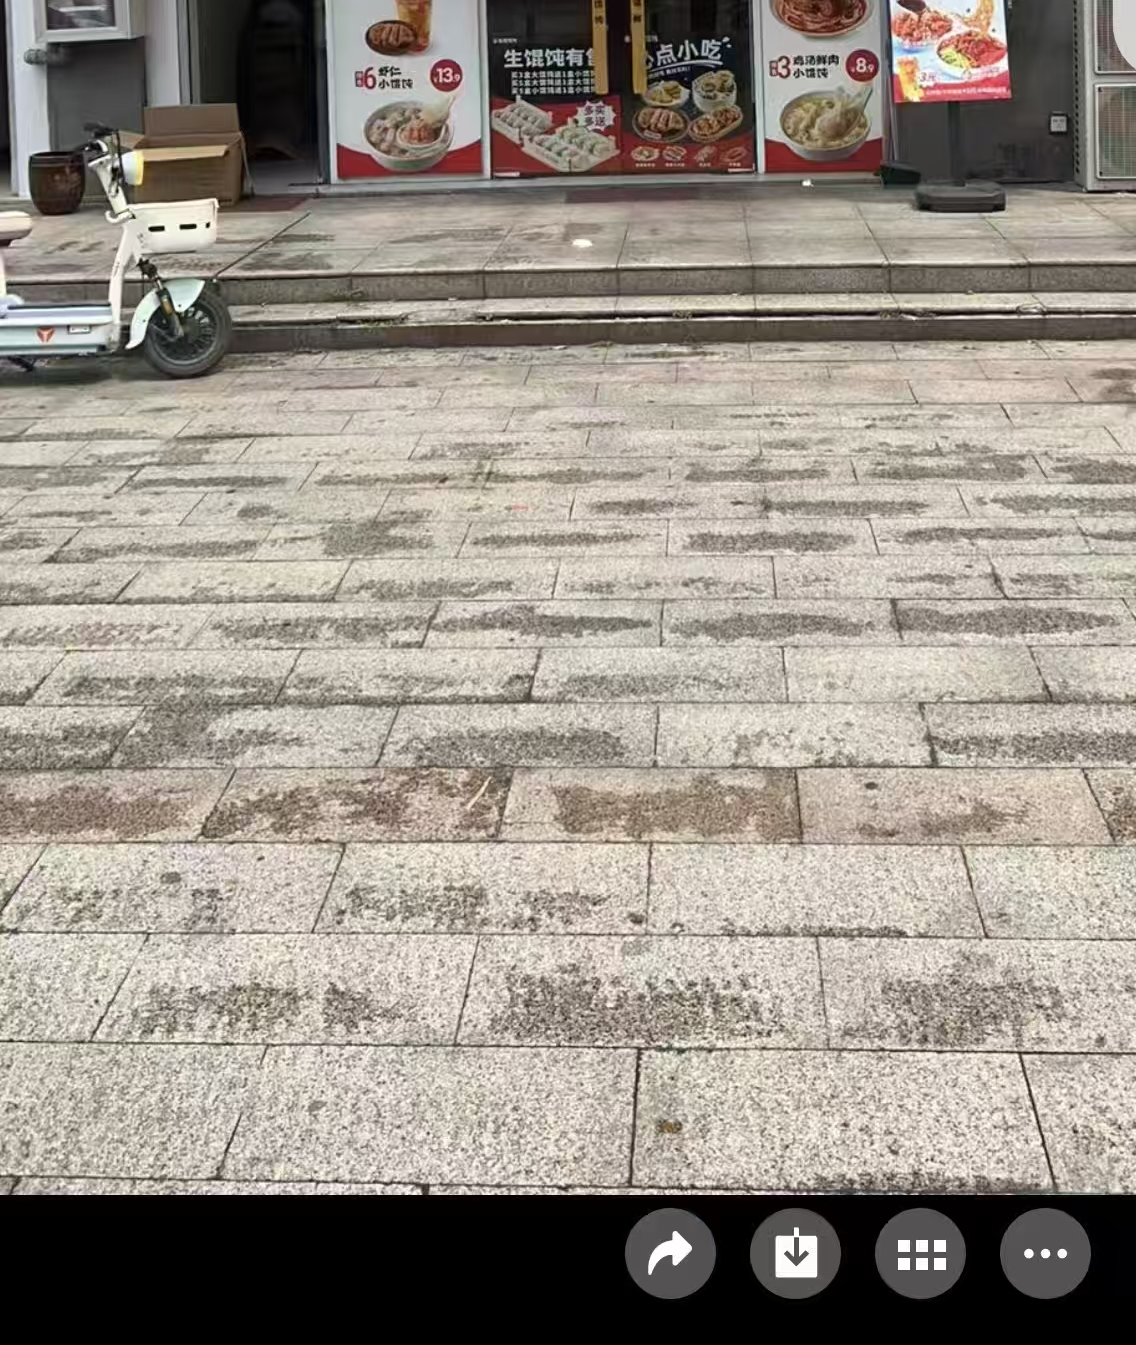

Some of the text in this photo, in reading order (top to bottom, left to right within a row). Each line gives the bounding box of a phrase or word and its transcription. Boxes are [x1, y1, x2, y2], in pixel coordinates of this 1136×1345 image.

[378, 66, 402, 77] 虾仁
[778, 55, 791, 79] 3
[793, 67, 828, 79] 小馄饨
[364, 66, 377, 90] 6
[379, 78, 413, 89] 小馄饨
